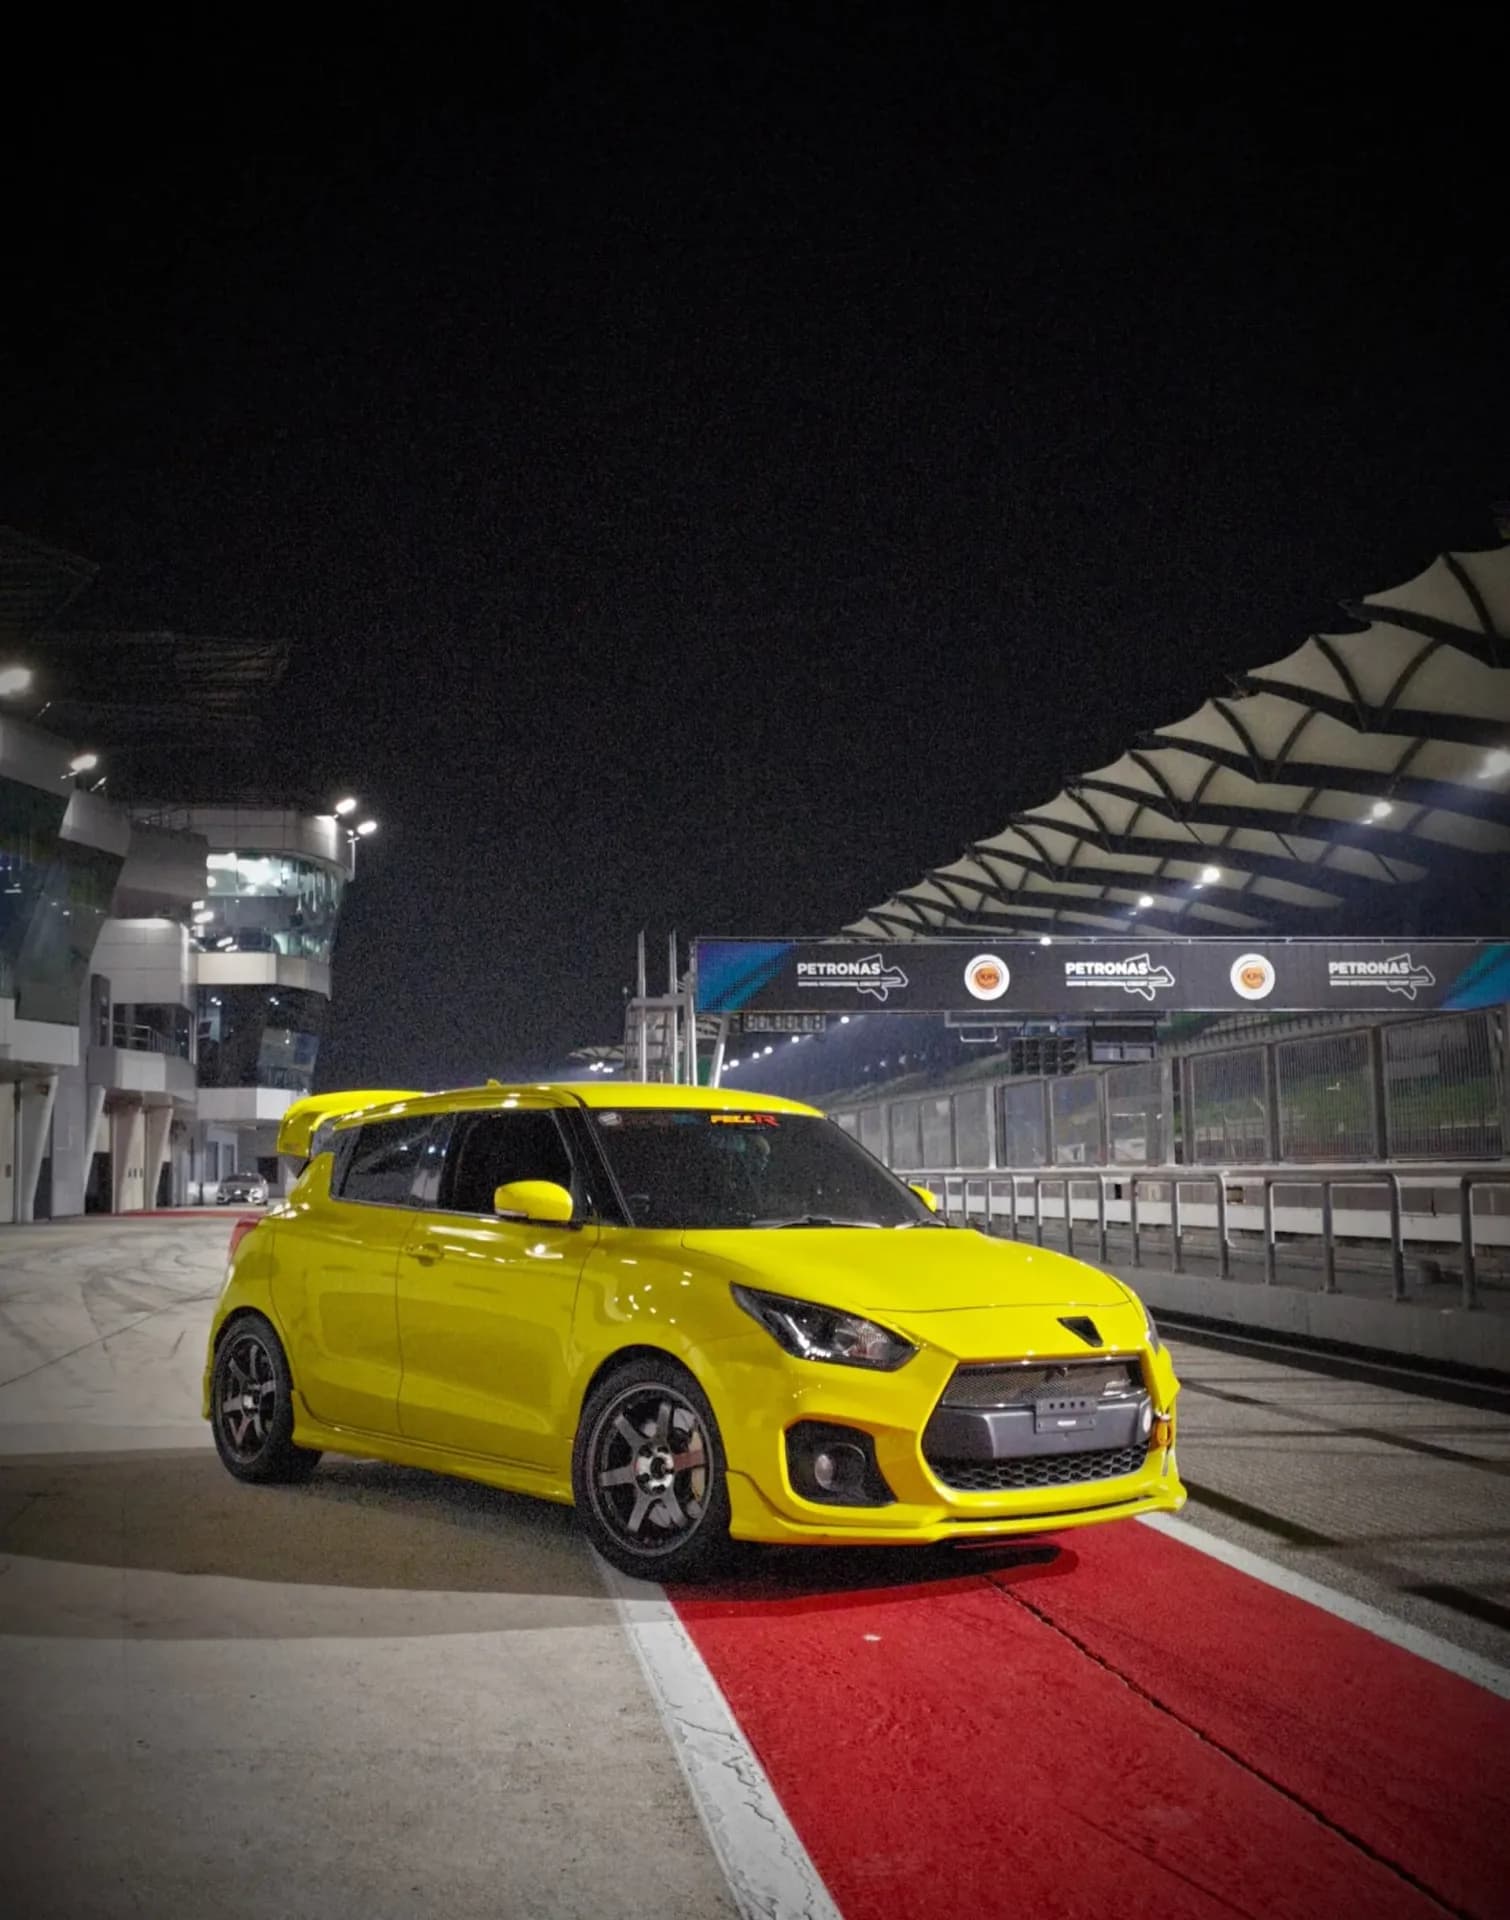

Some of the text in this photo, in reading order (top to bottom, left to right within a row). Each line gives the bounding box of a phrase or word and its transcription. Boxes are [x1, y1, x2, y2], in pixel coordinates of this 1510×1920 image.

[797, 962, 880, 975] PETRONAS
[1065, 962, 1148, 975] PETRONAS
[1328, 961, 1410, 974] PETRONAS
